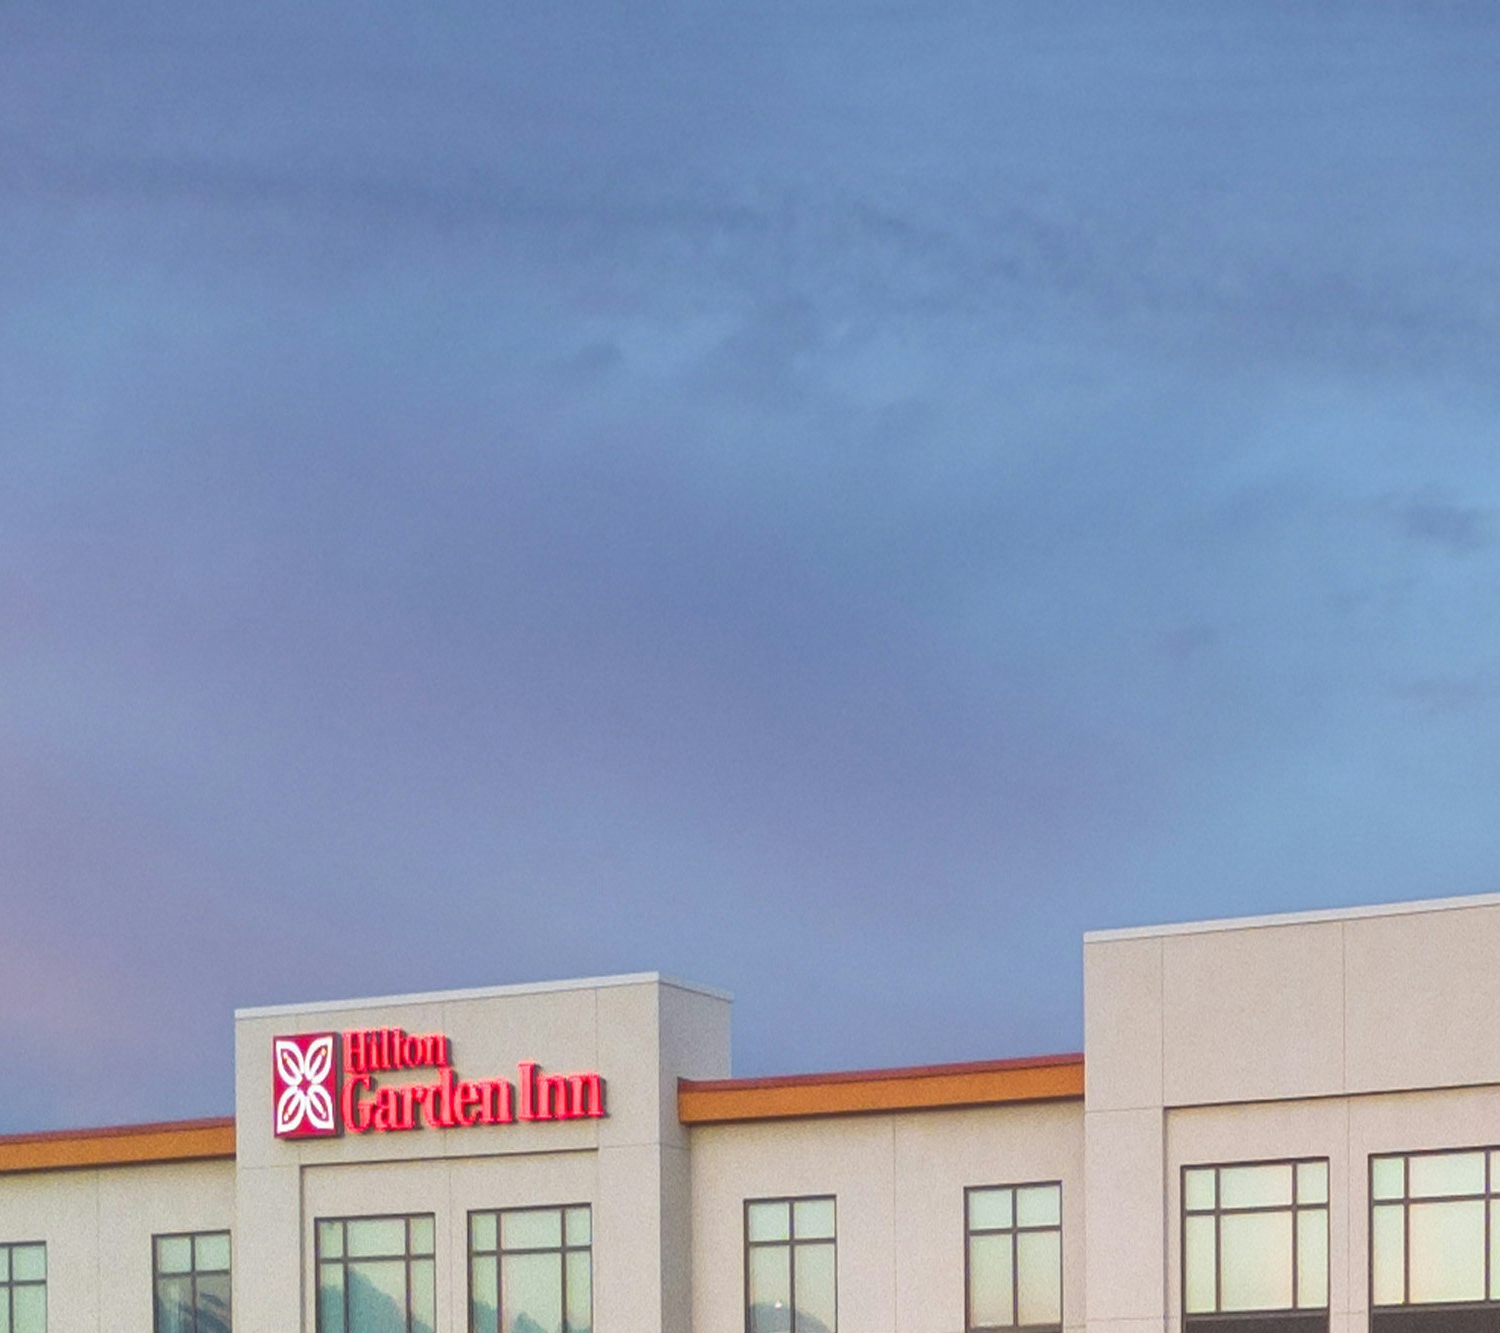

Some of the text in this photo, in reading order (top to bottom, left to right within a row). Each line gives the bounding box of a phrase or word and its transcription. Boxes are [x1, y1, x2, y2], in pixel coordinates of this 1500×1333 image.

[342, 1028, 448, 1071] Hilton
[342, 1061, 604, 1132] Garden Inn
